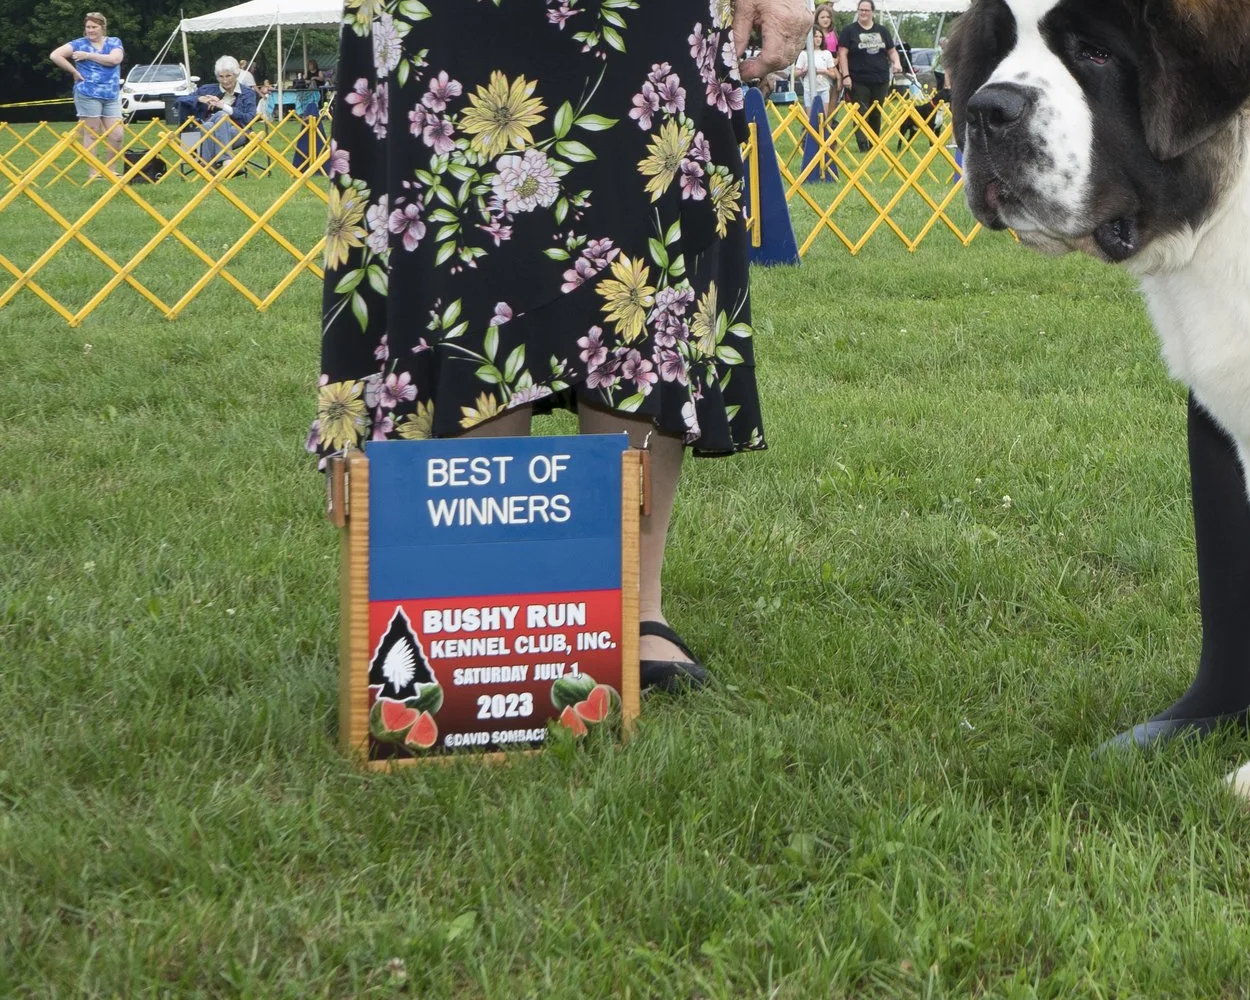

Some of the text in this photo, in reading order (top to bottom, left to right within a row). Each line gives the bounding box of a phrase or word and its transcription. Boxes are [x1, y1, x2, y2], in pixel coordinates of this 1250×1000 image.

[427, 454, 571, 487] BEST OF
[427, 494, 571, 527] WINNERS
[422, 602, 586, 634] BUSHY RUN
[430, 631, 617, 659] KENNEL CLUB, INC.
[453, 665, 529, 685] SATURDAY
[533, 662, 566, 680] JULY
[476, 692, 534, 719] 2023
